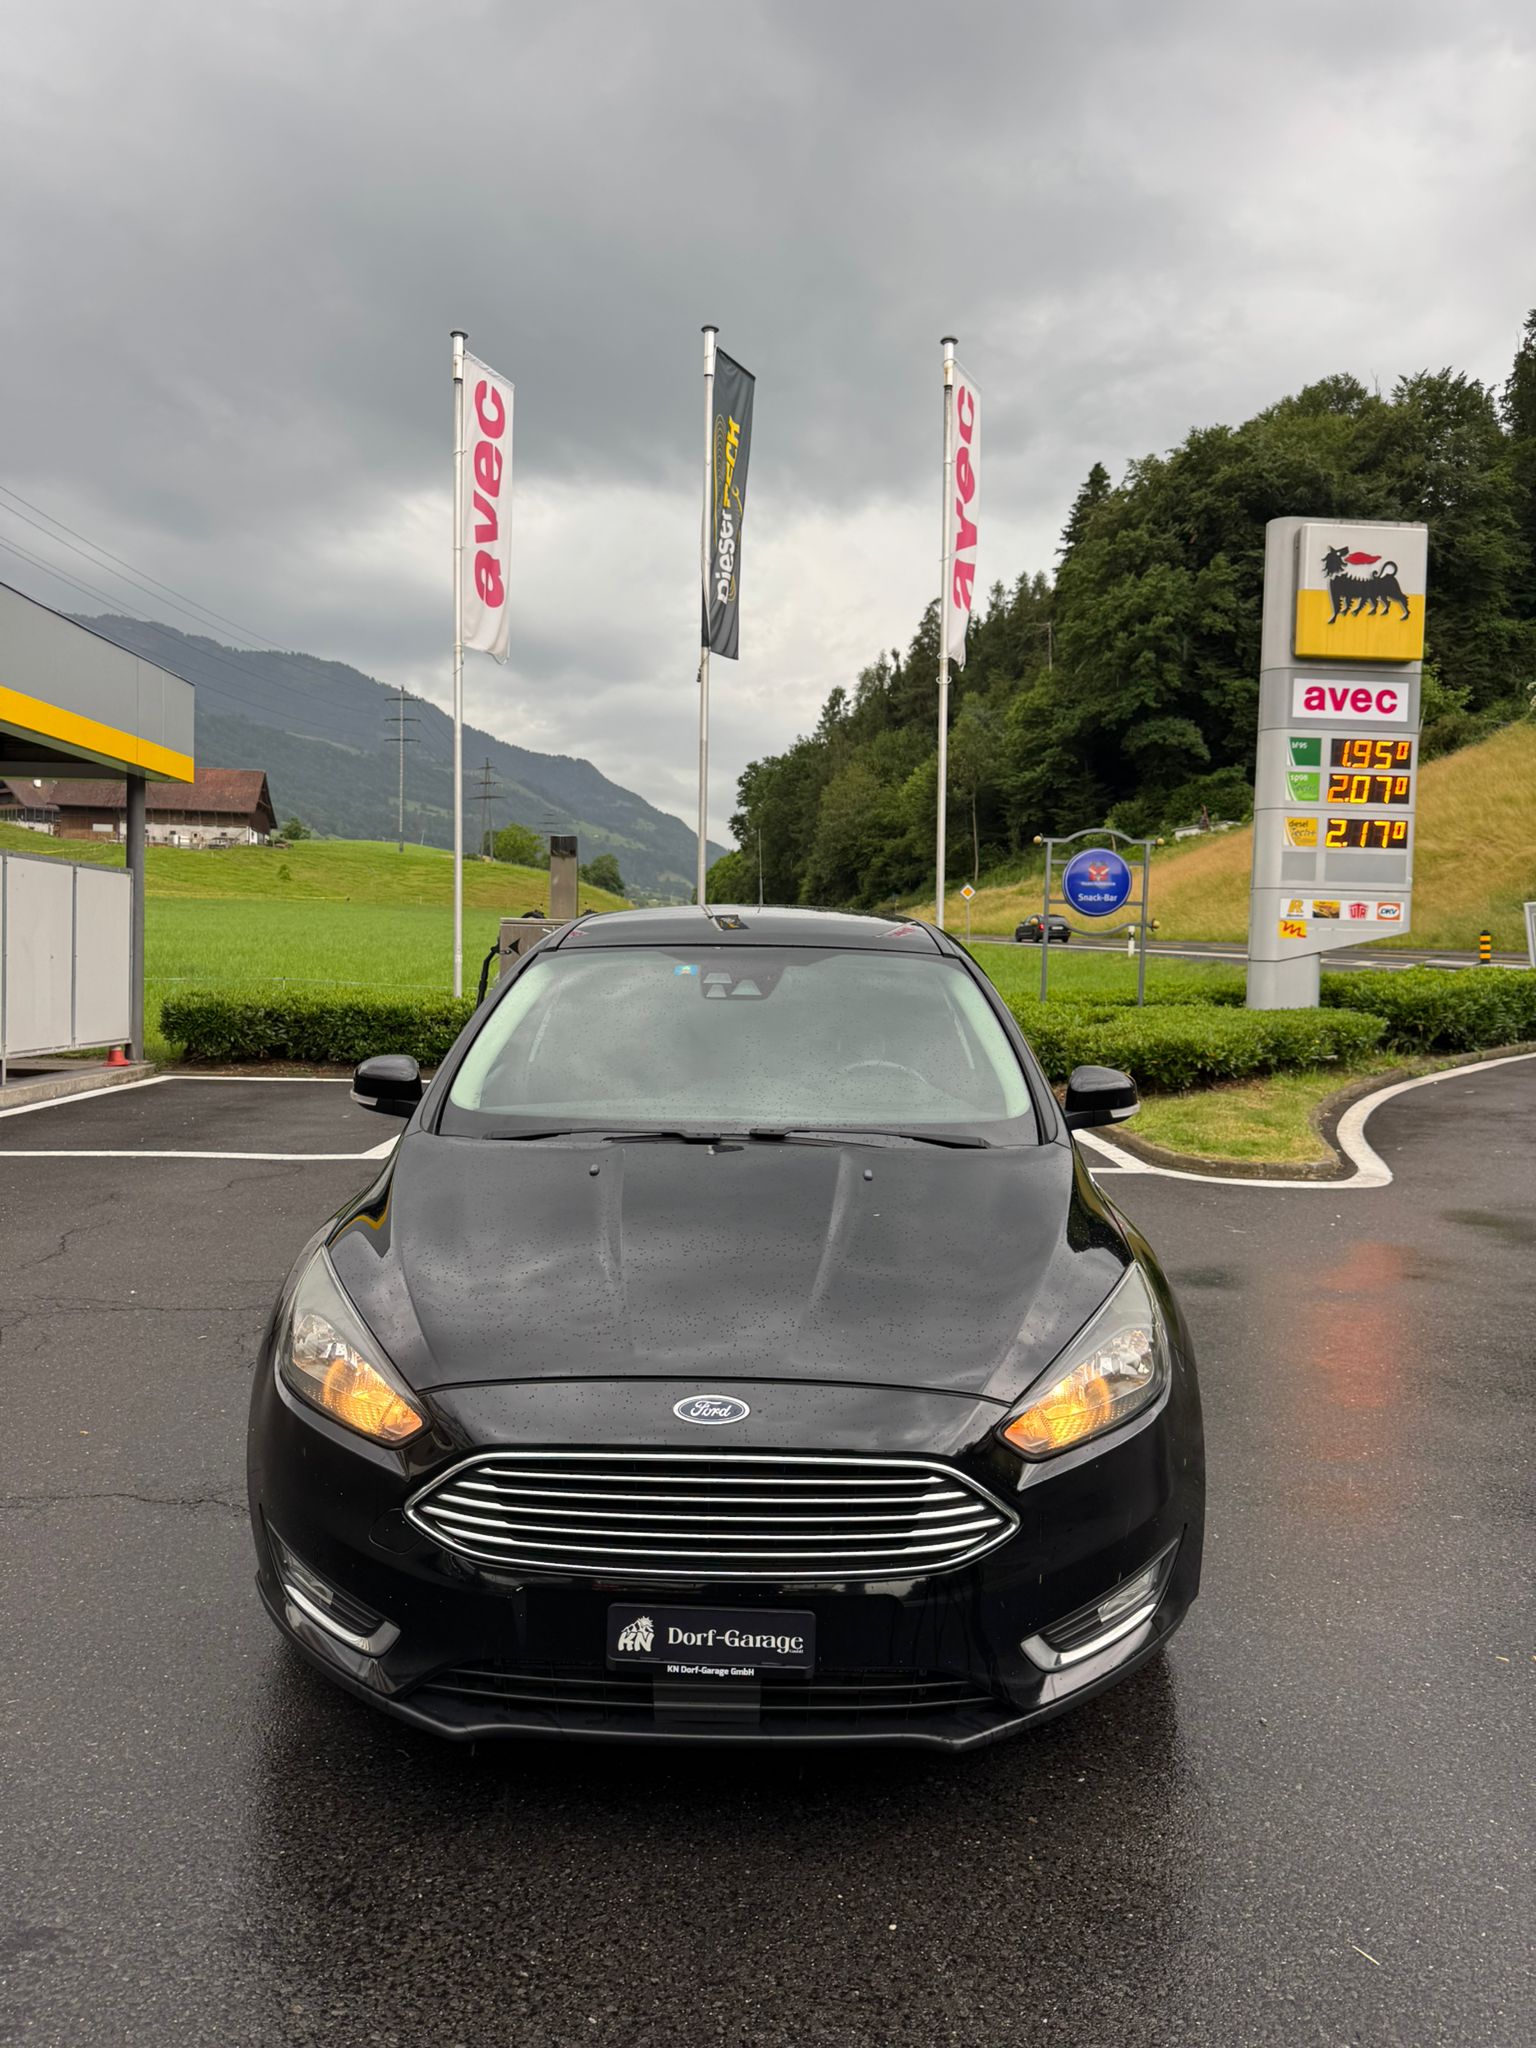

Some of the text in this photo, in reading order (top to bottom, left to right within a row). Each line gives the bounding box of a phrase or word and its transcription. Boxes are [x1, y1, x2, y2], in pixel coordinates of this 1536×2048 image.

[473, 379, 506, 608] avec
[952, 385, 978, 612] avec
[1303, 686, 1398, 714] avec
[1078, 893, 1118, 902] Snack-Bar
[1380, 907, 1397, 915] DKV
[690, 1400, 732, 1417] Ford
[618, 1631, 655, 1652] KN
[668, 1627, 804, 1654] Dorf-Garage
[667, 1664, 755, 1677] KN Dorf-Garage GmbH
